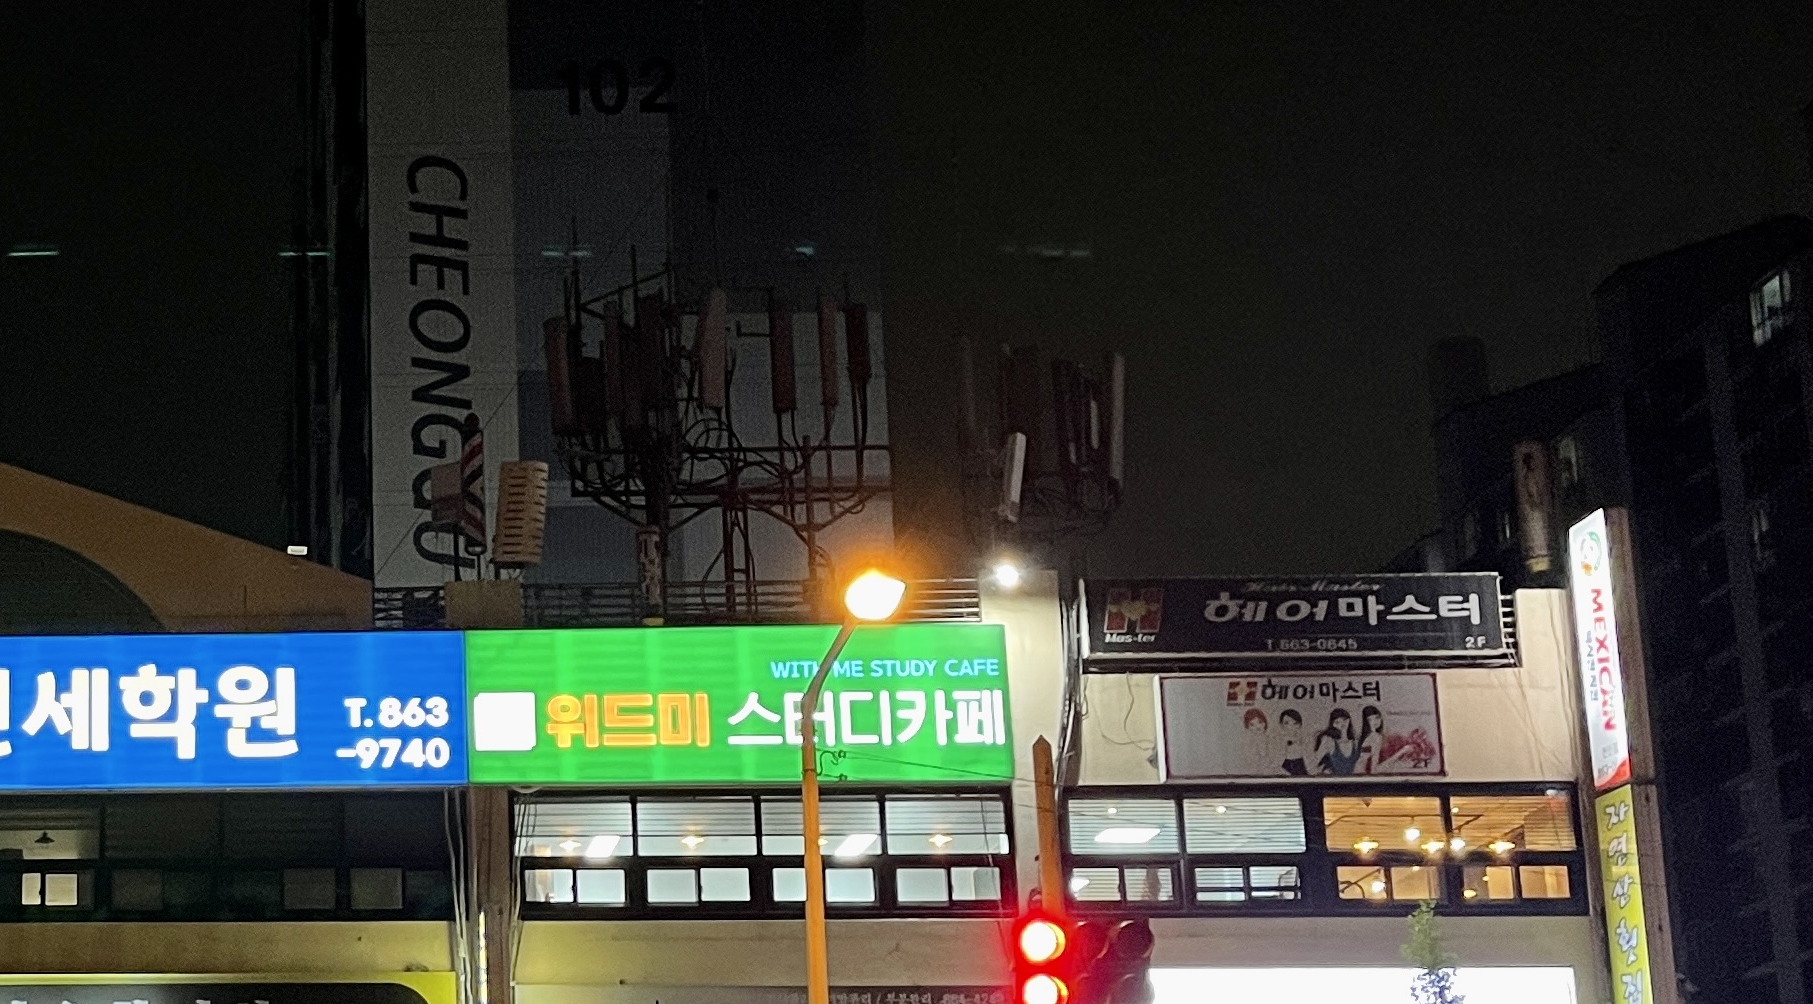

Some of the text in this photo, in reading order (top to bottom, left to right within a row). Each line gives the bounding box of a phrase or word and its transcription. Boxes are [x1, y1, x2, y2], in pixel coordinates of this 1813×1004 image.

[557, 57, 679, 116] 102
[1204, 591, 1481, 626] 헤어마스터
[1465, 636, 1486, 649] 2F
[832, 659, 866, 677] ME
[870, 658, 937, 677] STUDY
[944, 658, 999, 677] CAFE
[1590, 588, 1617, 732] MEXICAN
[1261, 678, 1382, 703] 헤어마스터
[343, 695, 449, 729] T.863
[546, 688, 1007, 748] 위드미 스터디카페
[335, 736, 451, 770] -9740
